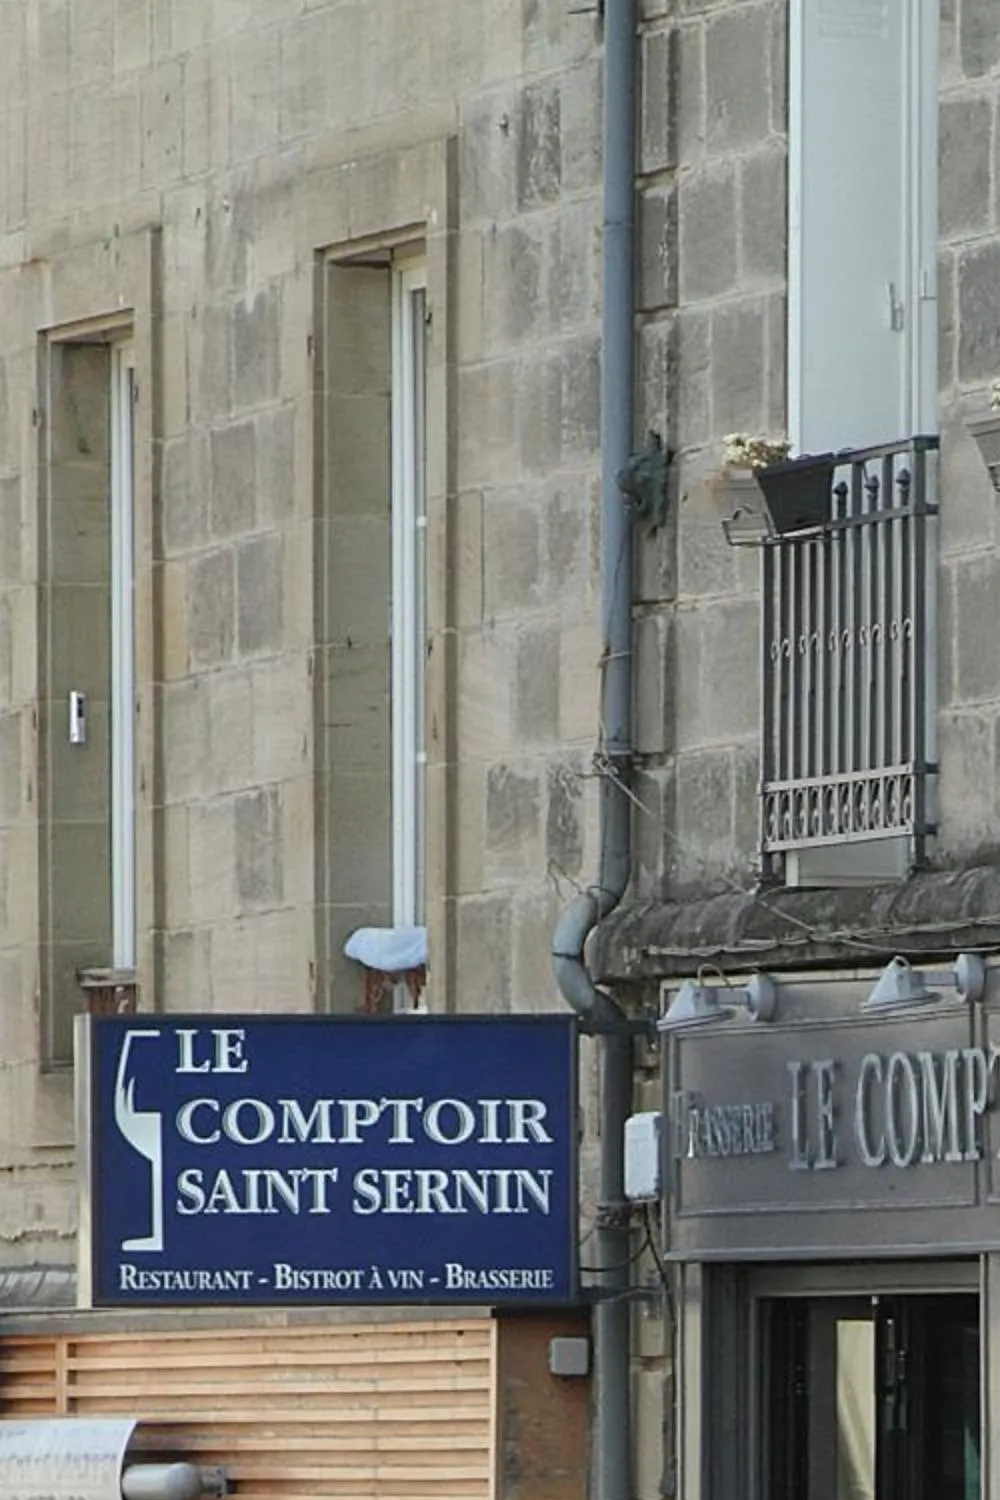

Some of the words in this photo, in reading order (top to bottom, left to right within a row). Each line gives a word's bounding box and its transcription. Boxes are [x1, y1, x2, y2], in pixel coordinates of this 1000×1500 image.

[174, 1028, 249, 1074] LE
[175, 1096, 555, 1145] COMPTOIR
[785, 1058, 838, 1171] LE
[175, 1167, 339, 1216] SAINT
[351, 1168, 555, 1216] SERNIN
[119, 1264, 253, 1291] RESTAURANT
[273, 1263, 365, 1291] BISTROT
[444, 1263, 555, 1291] BRASSERIE
